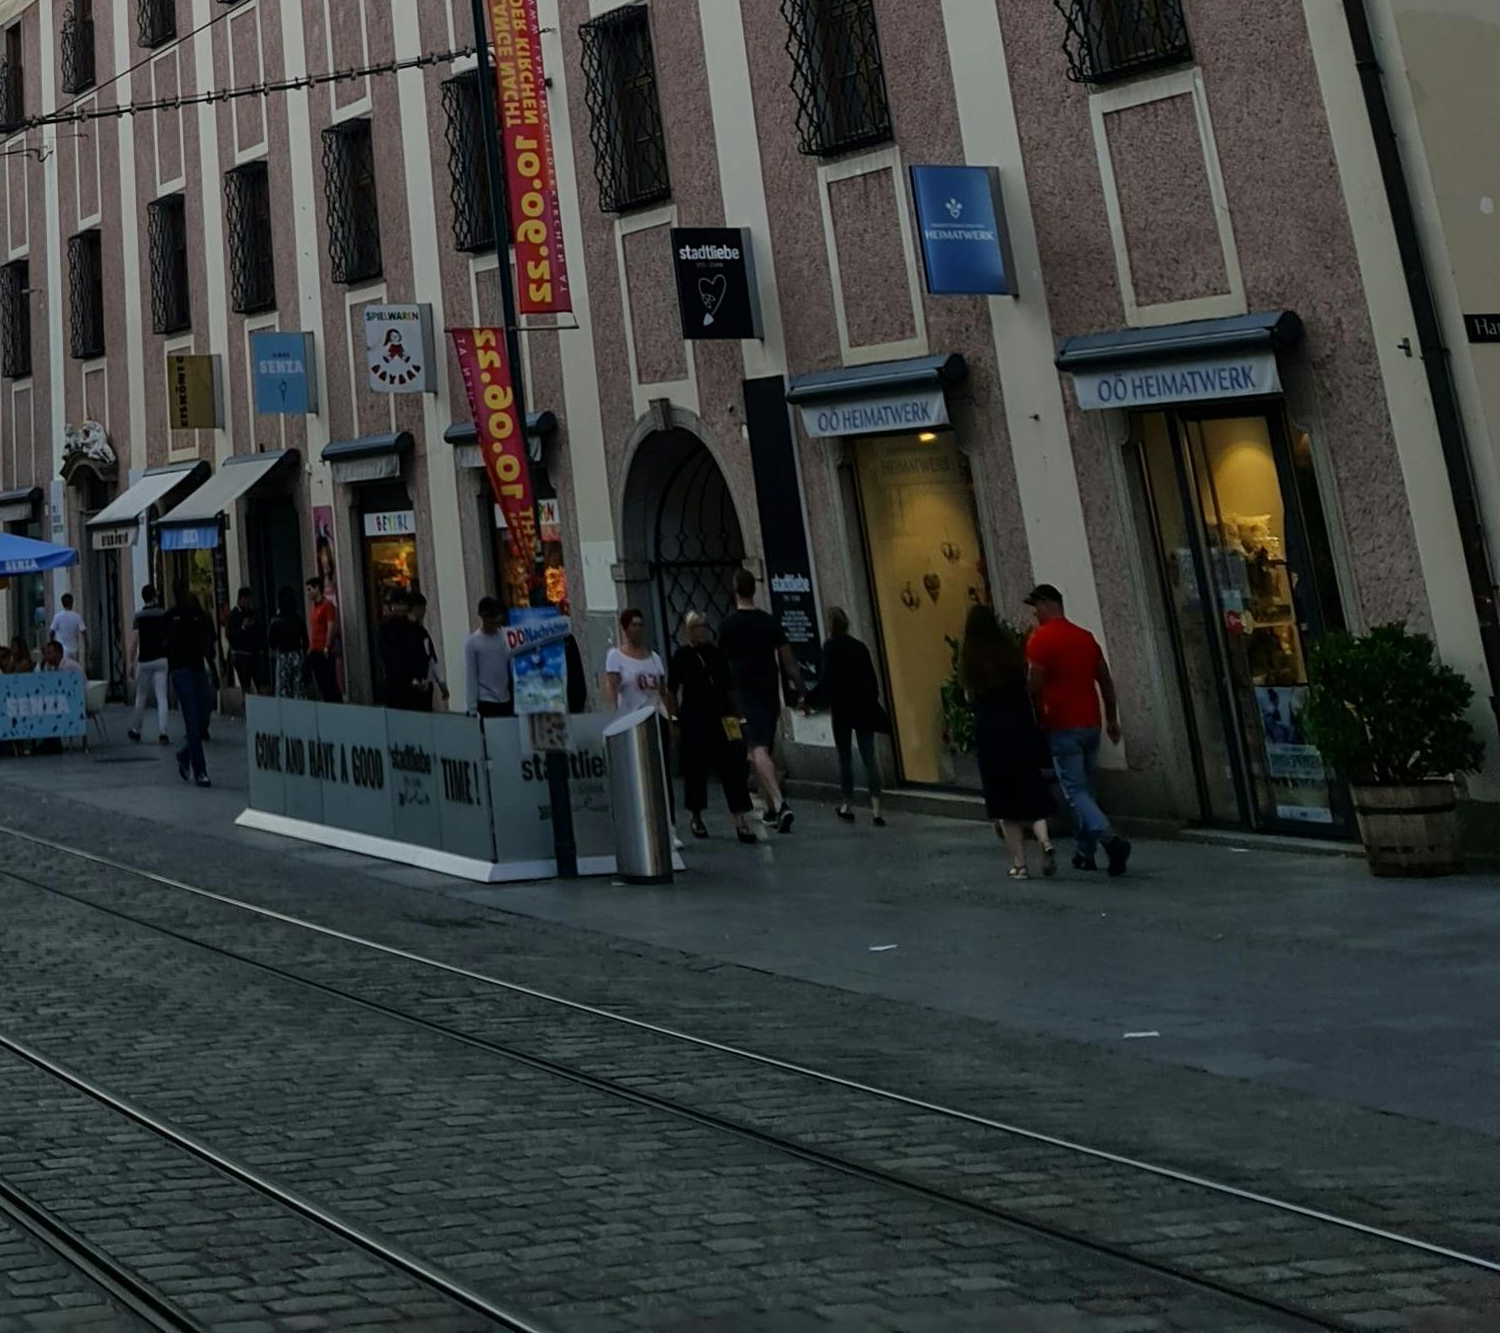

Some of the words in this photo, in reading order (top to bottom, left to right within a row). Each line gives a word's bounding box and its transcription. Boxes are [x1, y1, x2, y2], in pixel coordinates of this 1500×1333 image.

[924, 229, 995, 242] HEIMATWERK
[678, 244, 741, 261] stadtliebe
[365, 311, 419, 322] SPIELWAREN
[258, 360, 305, 374] SENZA
[1097, 373, 1128, 403] OÖ
[1131, 364, 1257, 399] HEIMATWERK
[817, 405, 841, 432] OÖ
[843, 400, 932, 430] HEIMATWERK
[4, 558, 40, 572] SENZA
[5, 695, 71, 719] SENZA
[255, 730, 282, 774] COME
[284, 736, 306, 776] AND
[308, 739, 337, 783] HAVE
[340, 743, 349, 784] A
[351, 744, 384, 790] GOOD
